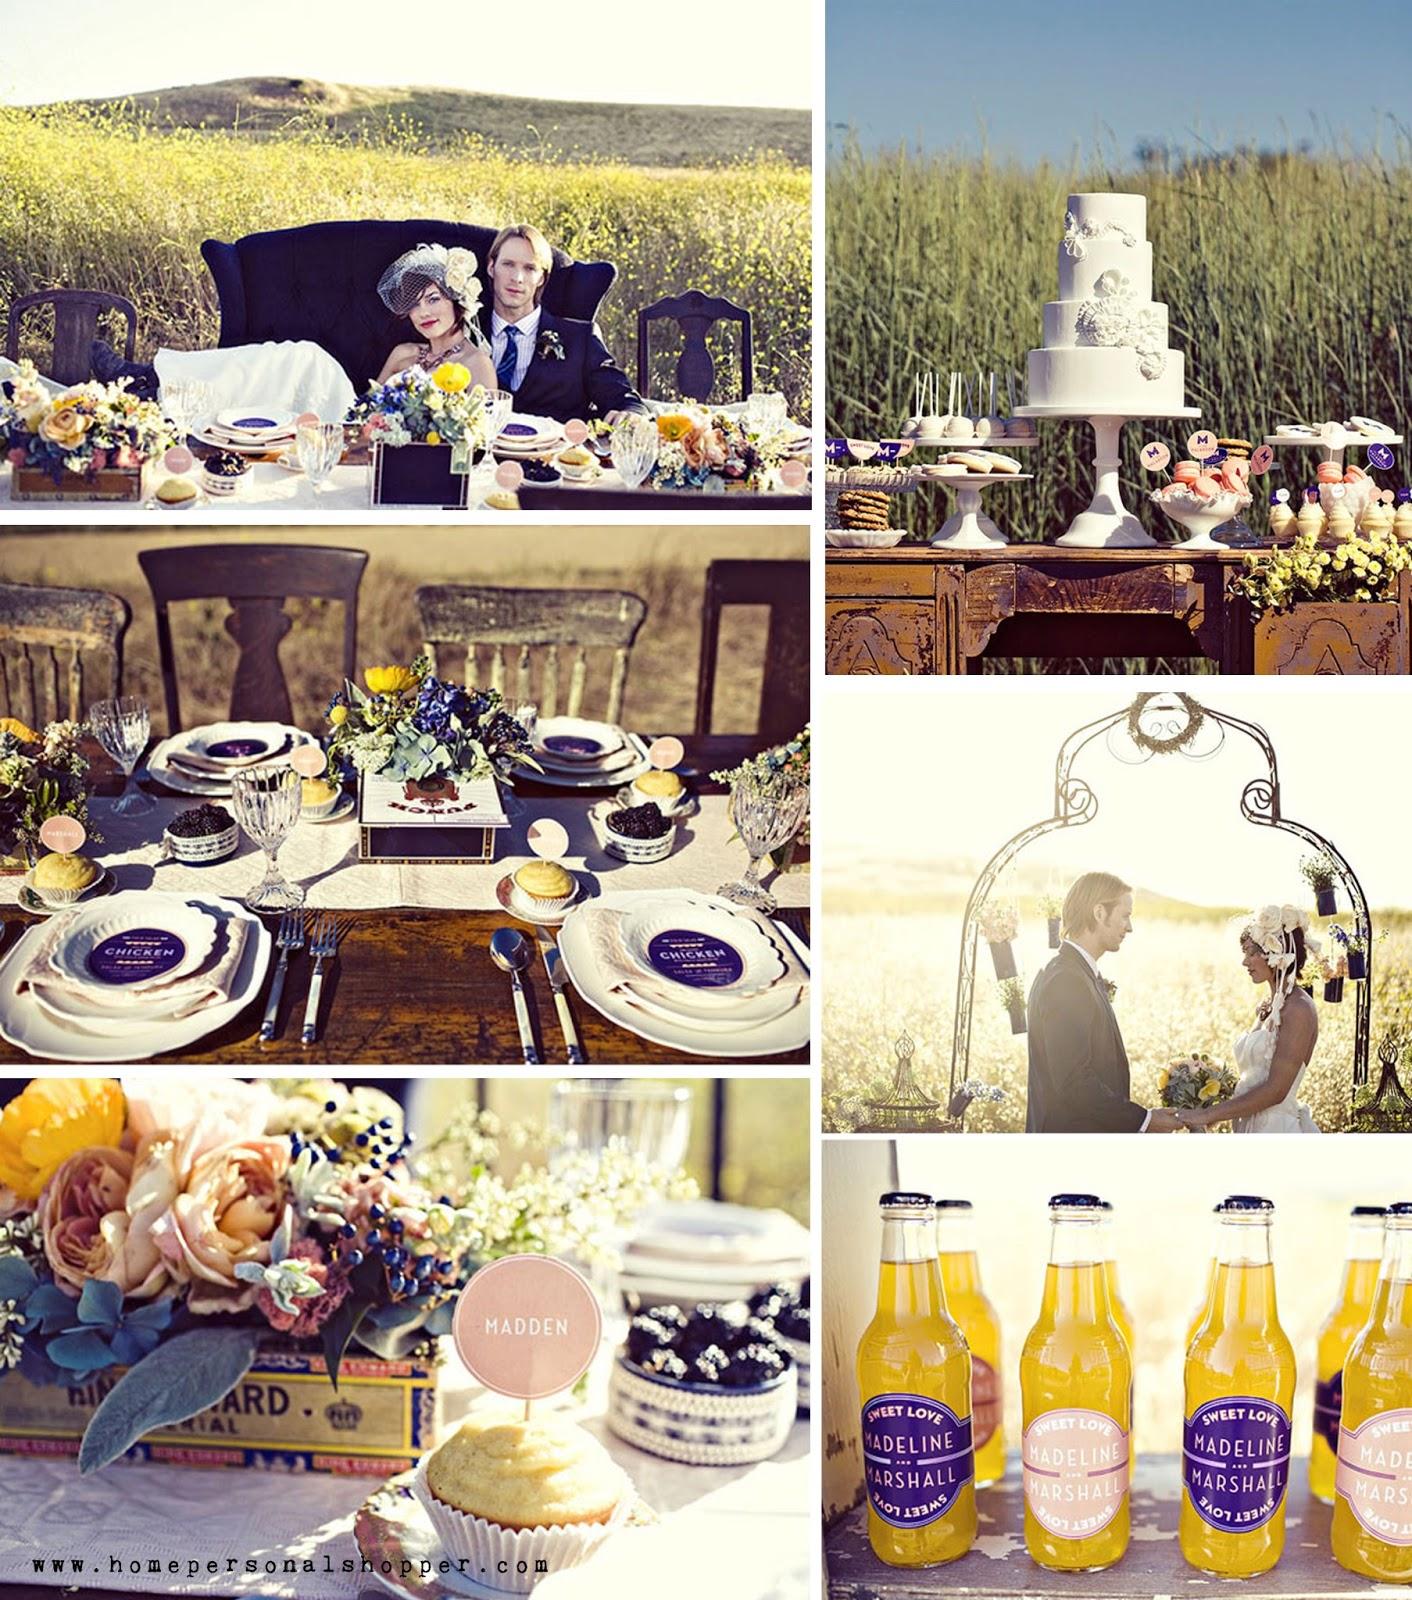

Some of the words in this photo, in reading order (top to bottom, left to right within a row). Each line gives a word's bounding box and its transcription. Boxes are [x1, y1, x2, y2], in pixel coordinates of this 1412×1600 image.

[104, 948, 175, 956] CHICKEN
[659, 949, 726, 960] CHICKEN
[485, 1317, 568, 1336] MADDEN
[868, 1405, 904, 1422] SWEET
[907, 1406, 944, 1425] LOVE
[1202, 1408, 1245, 1426] SWEET
[1248, 1409, 1279, 1428] LOVE
[1034, 1418, 1076, 1437] SWEET
[1080, 1419, 1113, 1437] LOVE
[1371, 1420, 1412, 1439] SWEE
[864, 1431, 953, 1454] MADELINE
[1030, 1442, 1120, 1467] MADELINE
[1194, 1433, 1284, 1457] MADELINE
[867, 1466, 956, 1489] MARSHALL
[1030, 1477, 1120, 1502] MARSHALL
[1192, 1468, 1282, 1493] MARSHALL
[873, 1491, 900, 1517] LOVE
[903, 1493, 948, 1518] SWEET
[1199, 1496, 1231, 1522] LOVE
[1234, 1497, 1275, 1522] SWEET
[1037, 1505, 1069, 1530] LOVE
[1072, 1505, 1113, 1530] SWEET
[1363, 1507, 1398, 1533] LOVE
